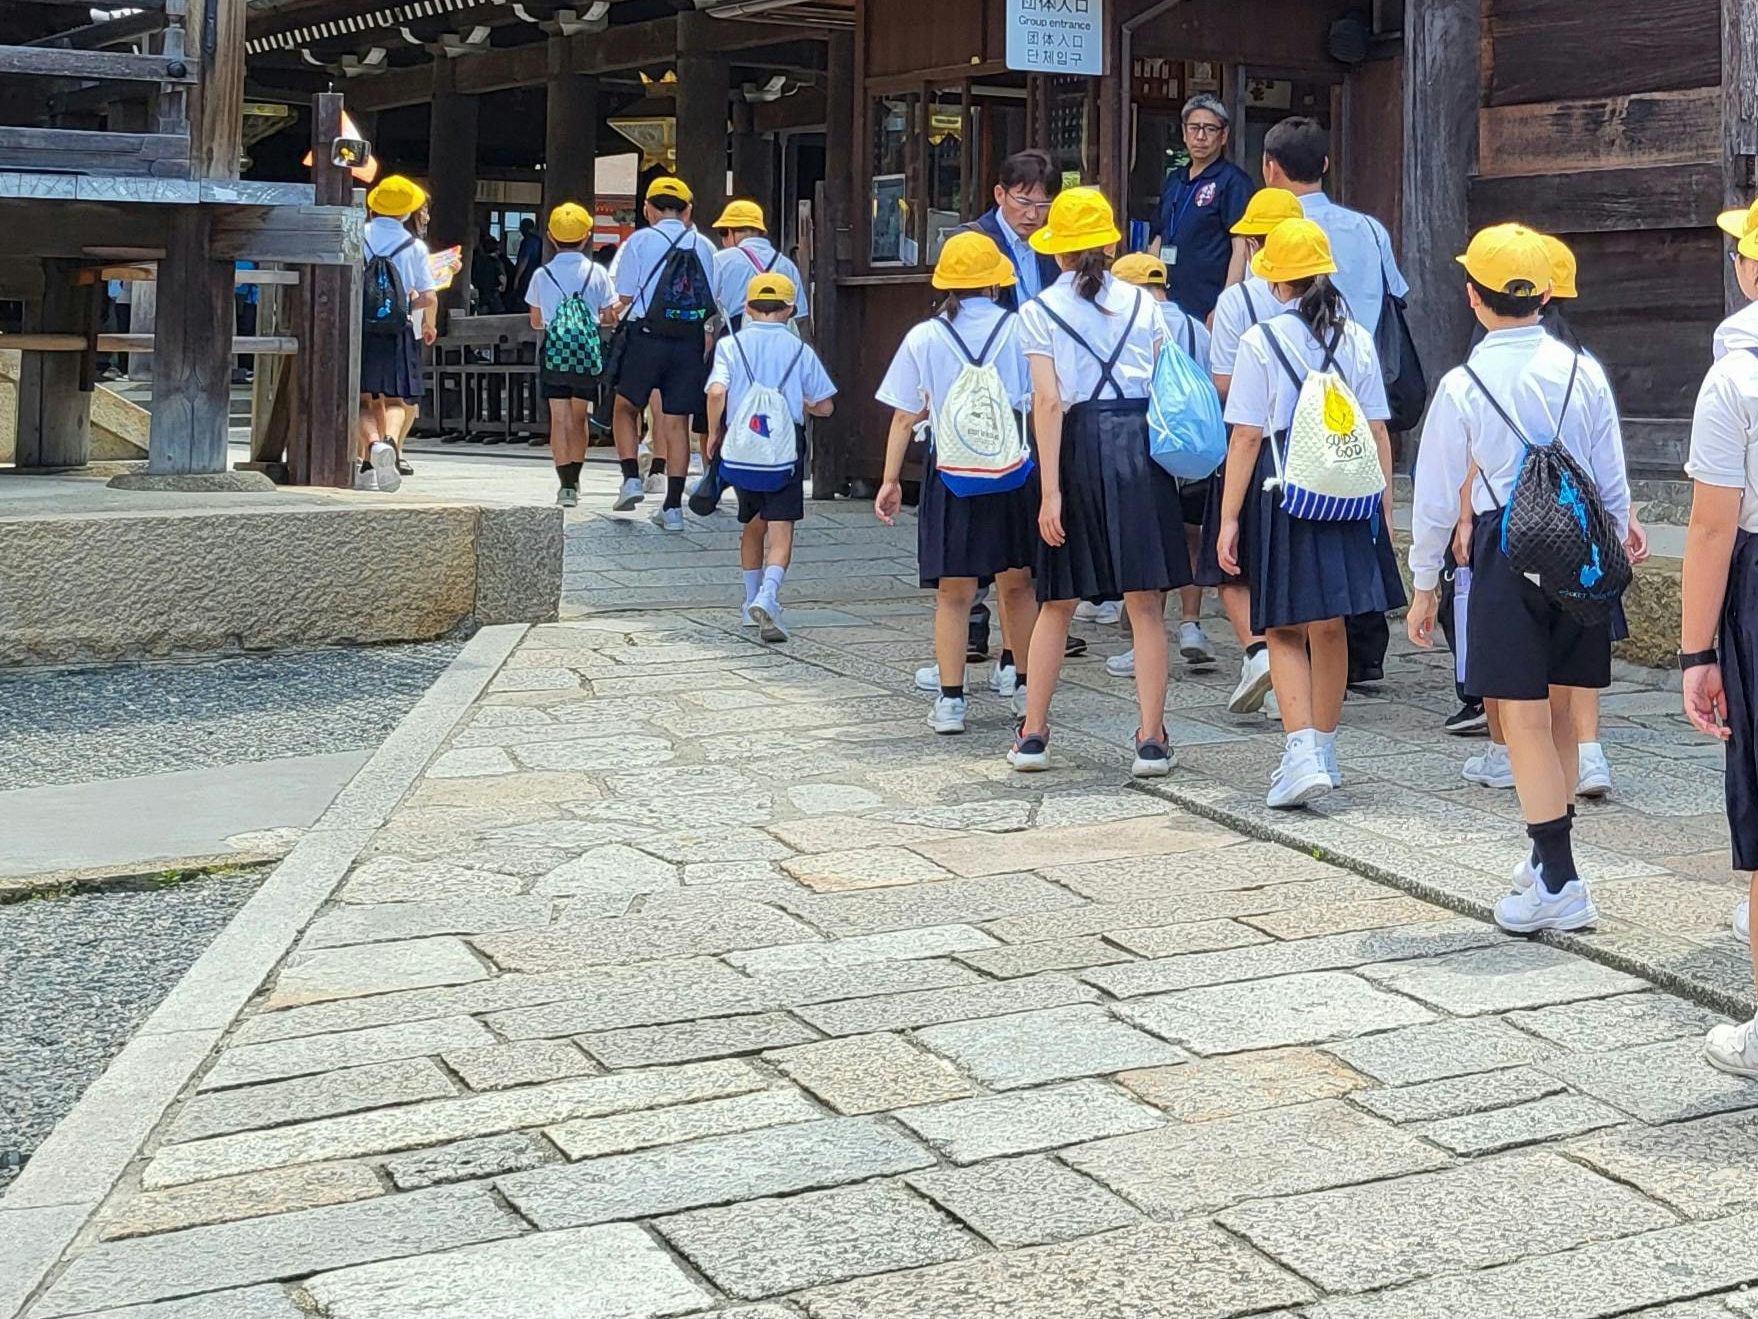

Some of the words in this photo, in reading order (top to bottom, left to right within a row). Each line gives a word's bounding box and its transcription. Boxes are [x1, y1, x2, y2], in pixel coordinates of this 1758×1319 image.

[1018, 14, 1048, 28] Group
[1049, 18, 1091, 31] entrance
[1026, 48, 1083, 67] 단체입구
